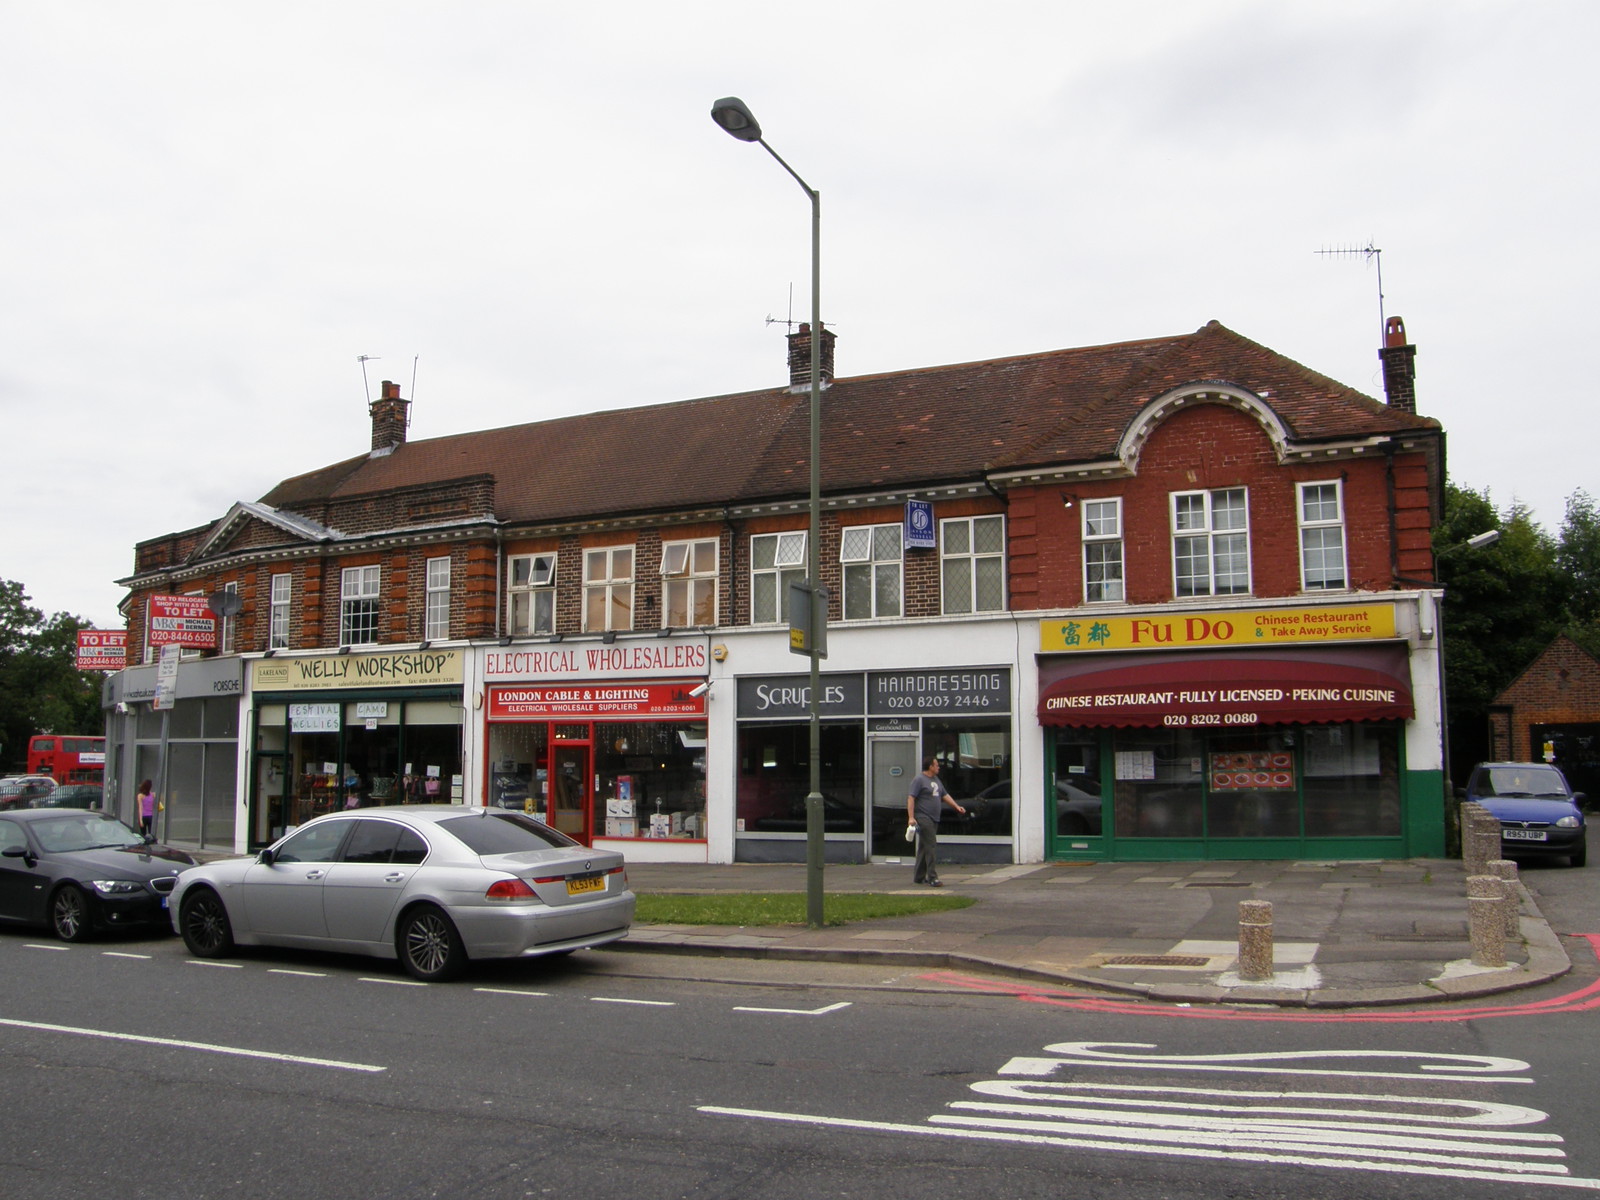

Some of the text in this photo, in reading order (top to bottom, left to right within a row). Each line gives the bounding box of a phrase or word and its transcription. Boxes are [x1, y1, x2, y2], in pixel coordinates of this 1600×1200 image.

[164, 607, 204, 617] TO LET
[1255, 611, 1368, 625] Chinese Restaurant
[151, 631, 216, 642] 020-8446 6505
[1061, 621, 1111, 646] 富都
[1256, 624, 1371, 637] & Take Away Service
[82, 636, 126, 645] TO LET
[486, 645, 705, 674] ELECTRICAL WHOLESALERS
[214, 680, 239, 692] PORSCHE
[879, 674, 1000, 692] HAIRDRESSING
[498, 689, 649, 701] LONDON CABLE & LIGHTING
[756, 684, 844, 710] SCRUPES
[1046, 689, 1395, 709] CHINESE RESTAURANT FULLY LICENSED PEKING CUISINE
[598, 703, 637, 711] SUPPLIERS
[888, 695, 989, 708] 020 8203 2446
[358, 705, 385, 713] CAMO
[293, 720, 338, 728] WELLIES
[1164, 713, 1257, 725] 020 8202 0080
[931, 782, 939, 796] 2
[570, 879, 588, 891] KL53
